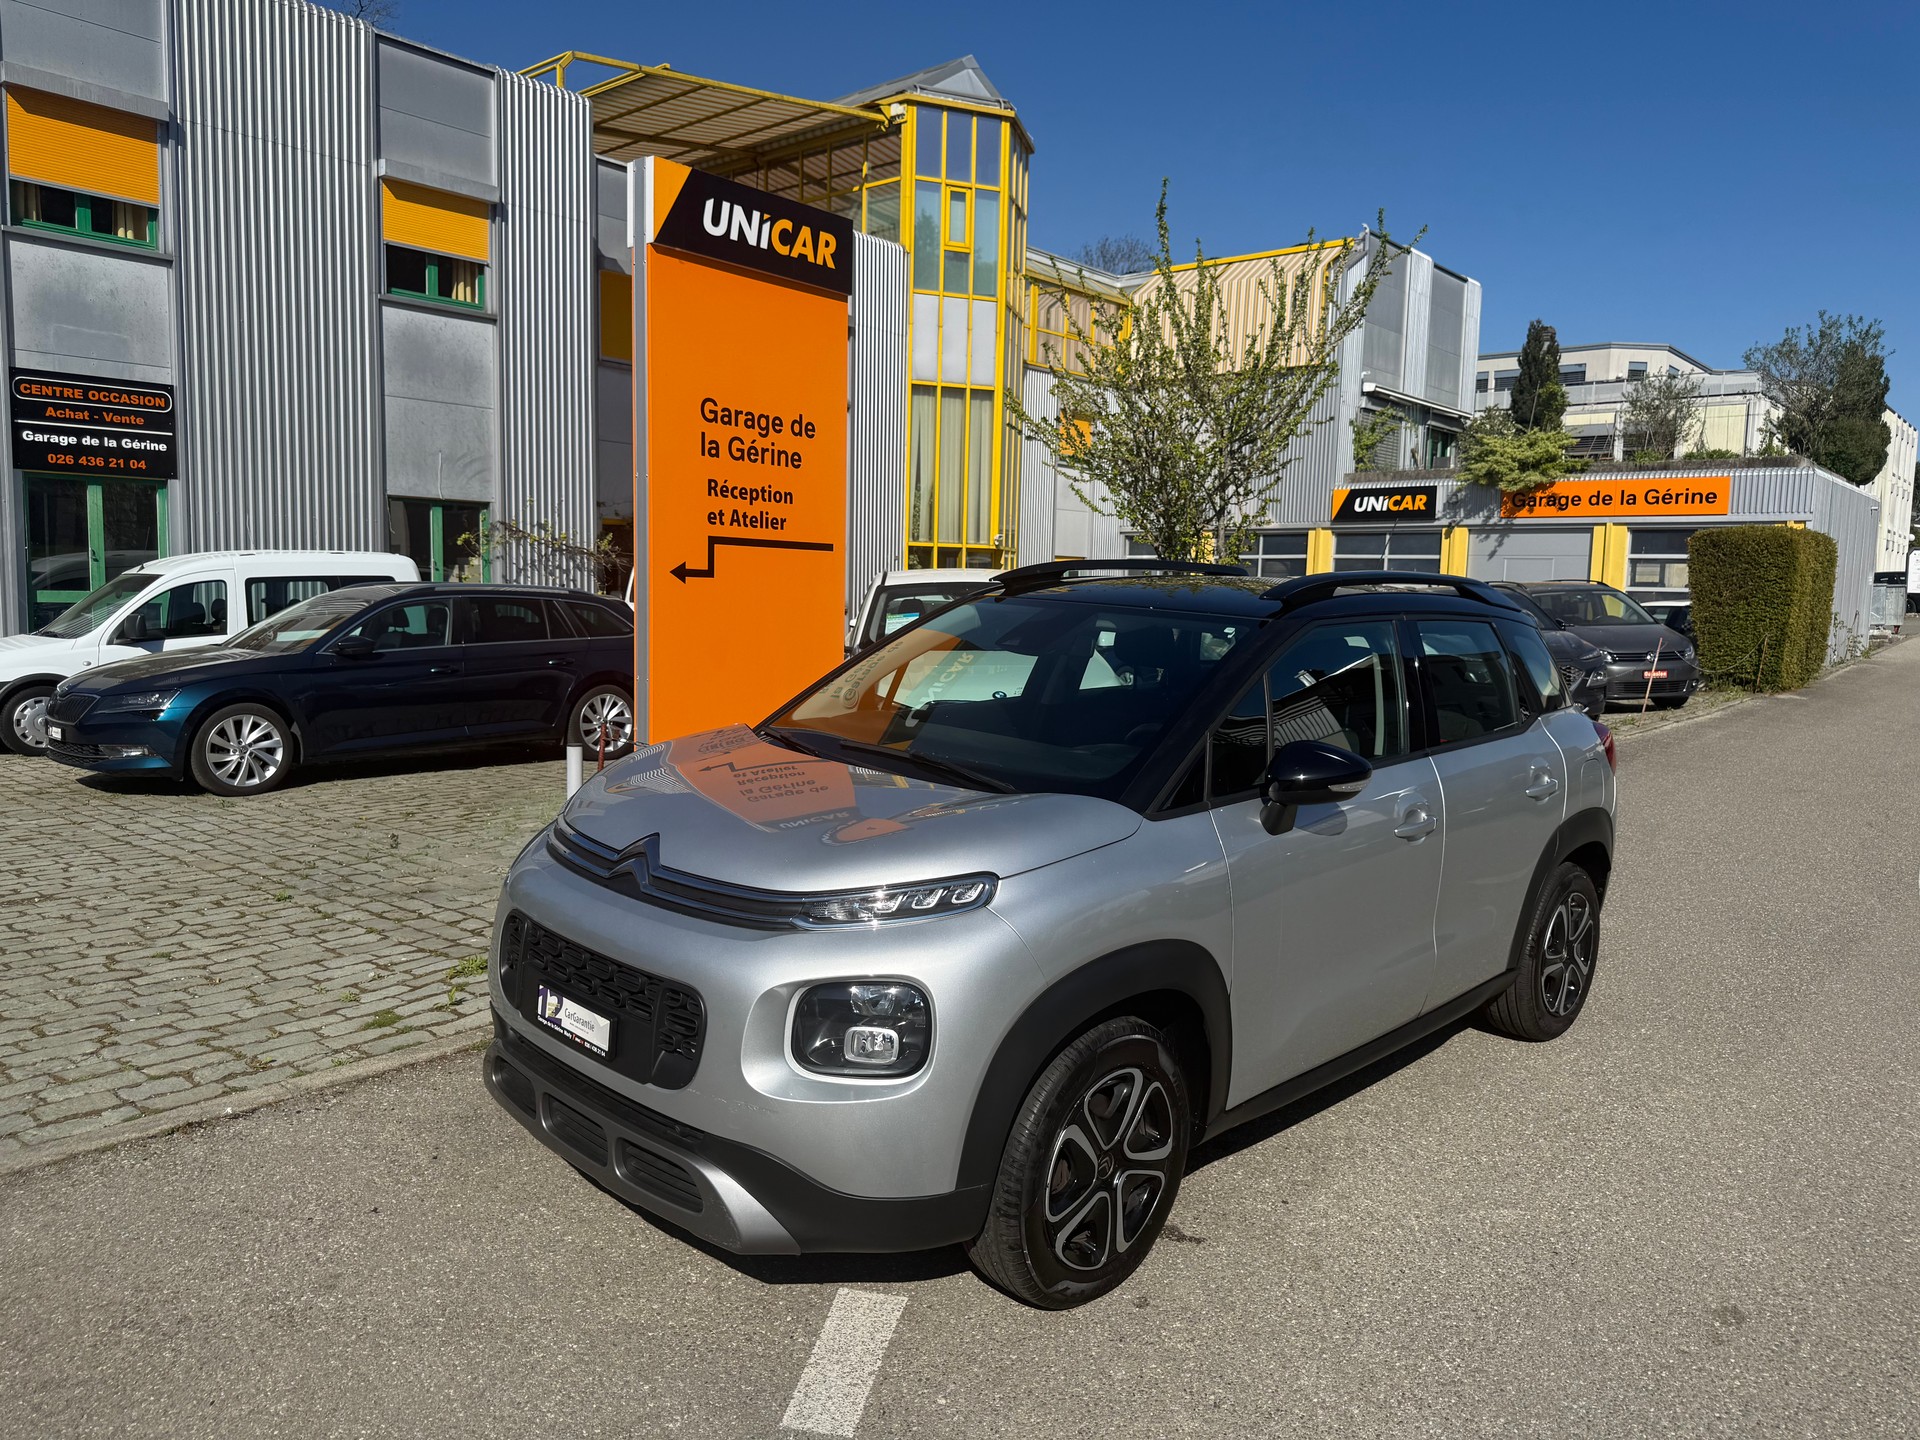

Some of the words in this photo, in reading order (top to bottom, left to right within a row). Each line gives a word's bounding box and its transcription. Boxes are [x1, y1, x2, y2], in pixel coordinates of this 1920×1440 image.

[19, 383, 84, 400] CENTRE
[88, 390, 166, 408] OCCASION
[45, 406, 90, 421] Achat
[102, 411, 145, 425] Vente
[700, 397, 784, 439] Garage
[790, 413, 816, 439] de
[22, 430, 78, 447] Garage
[82, 435, 100, 446] de
[104, 436, 118, 448] la
[121, 437, 168, 452] Gérine
[700, 431, 720, 459] la
[727, 436, 802, 470] Gérine
[47, 453, 75, 465] 026
[78, 455, 105, 467] 436
[108, 457, 125, 468] 21
[129, 459, 147, 470] 04
[707, 478, 794, 506] Réception
[1511, 491, 1583, 511] Garage
[1587, 490, 1614, 506] de
[1620, 489, 1637, 506] la
[1643, 488, 1718, 506] Gérine
[706, 508, 726, 527] et
[729, 509, 787, 531] Atelier
[564, 1008, 595, 1032] CarGarantie
